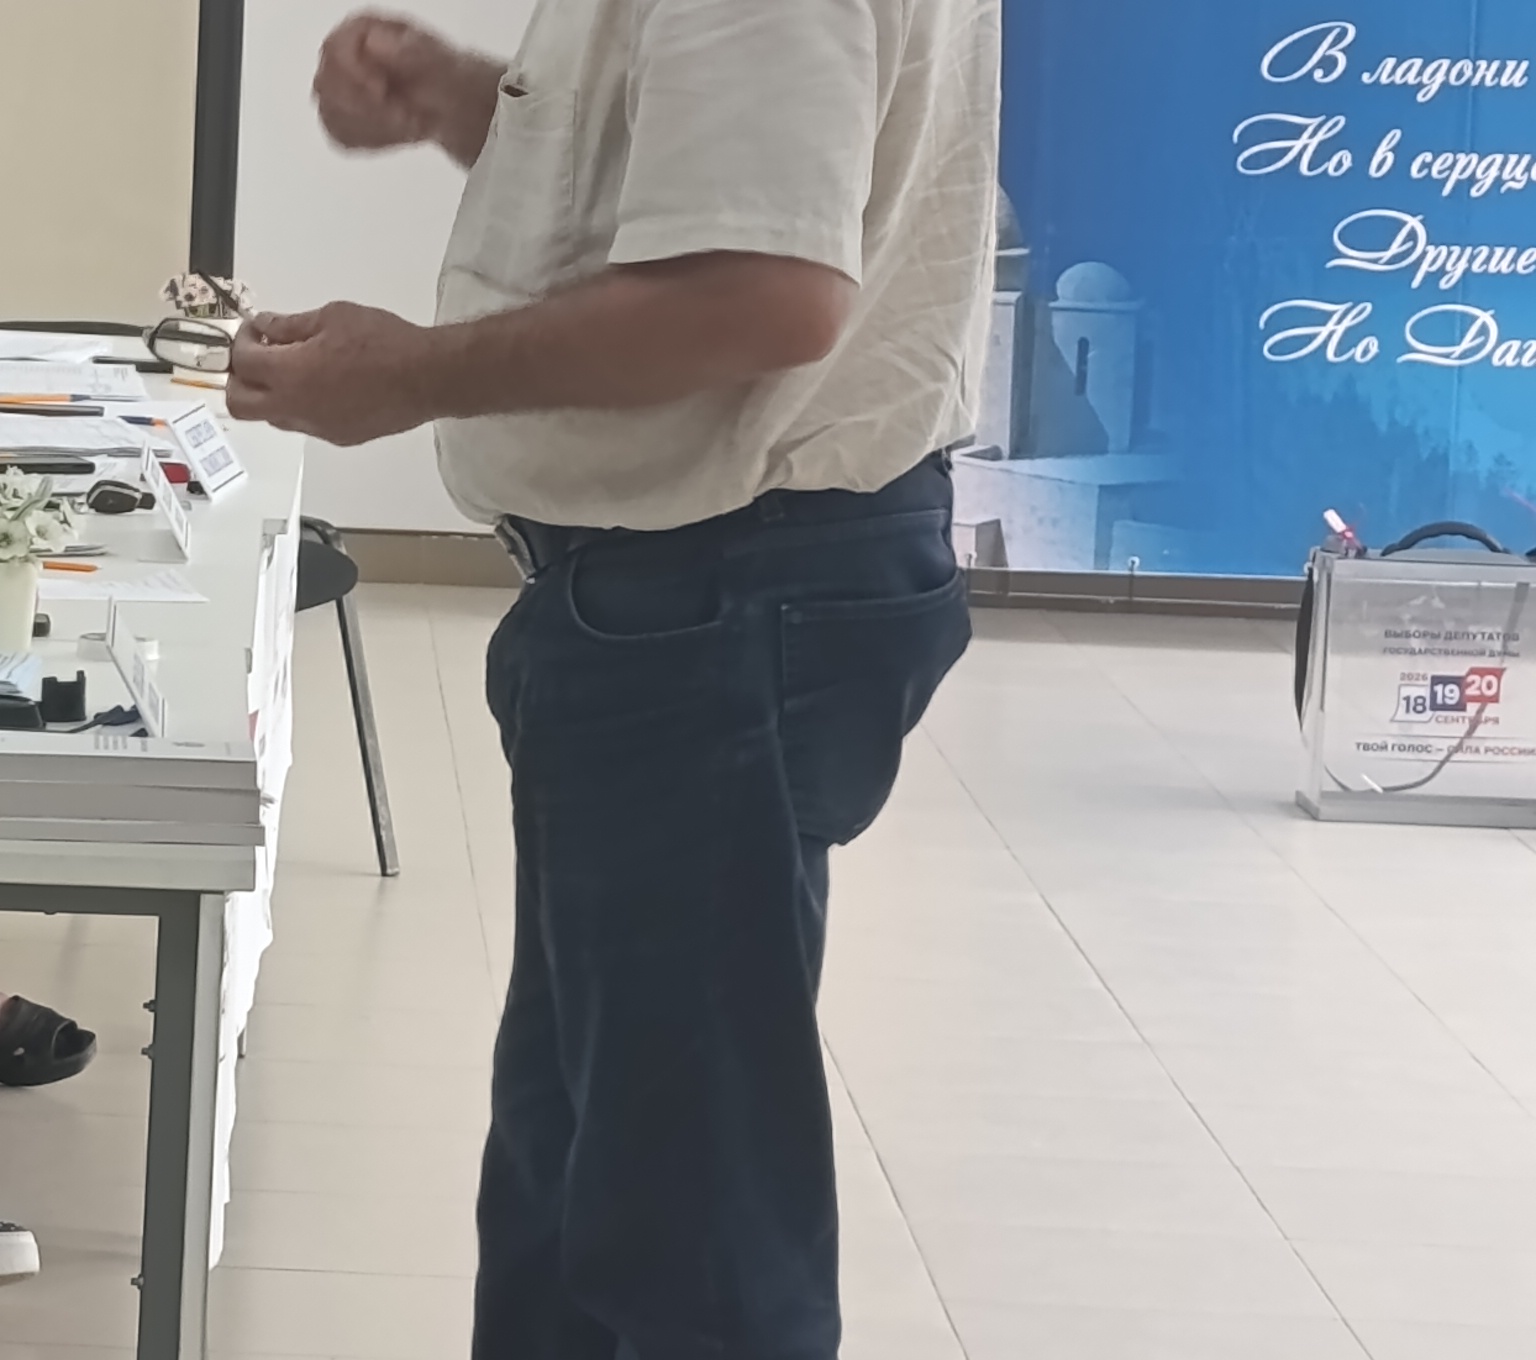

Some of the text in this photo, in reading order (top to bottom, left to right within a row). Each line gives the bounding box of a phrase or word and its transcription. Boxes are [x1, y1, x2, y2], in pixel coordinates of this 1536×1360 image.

[1260, 20, 1529, 102] В ладони
[1232, 112, 1536, 198] Но в сердц
[1325, 208, 1536, 291] Другие
[1258, 298, 1380, 364] Но
[1384, 629, 1520, 642] ВЫБОРЫ ДЕПУТАТОВ
[1399, 672, 1429, 682] 2026
[1464, 674, 1499, 697] 20
[1402, 695, 1427, 715] 18
[1433, 683, 1461, 705] 19
[1435, 714, 1500, 726] СЕНТРЯ
[1355, 741, 1389, 753] ТВОЙ
[1390, 744, 1433, 754] ГОЛОС
